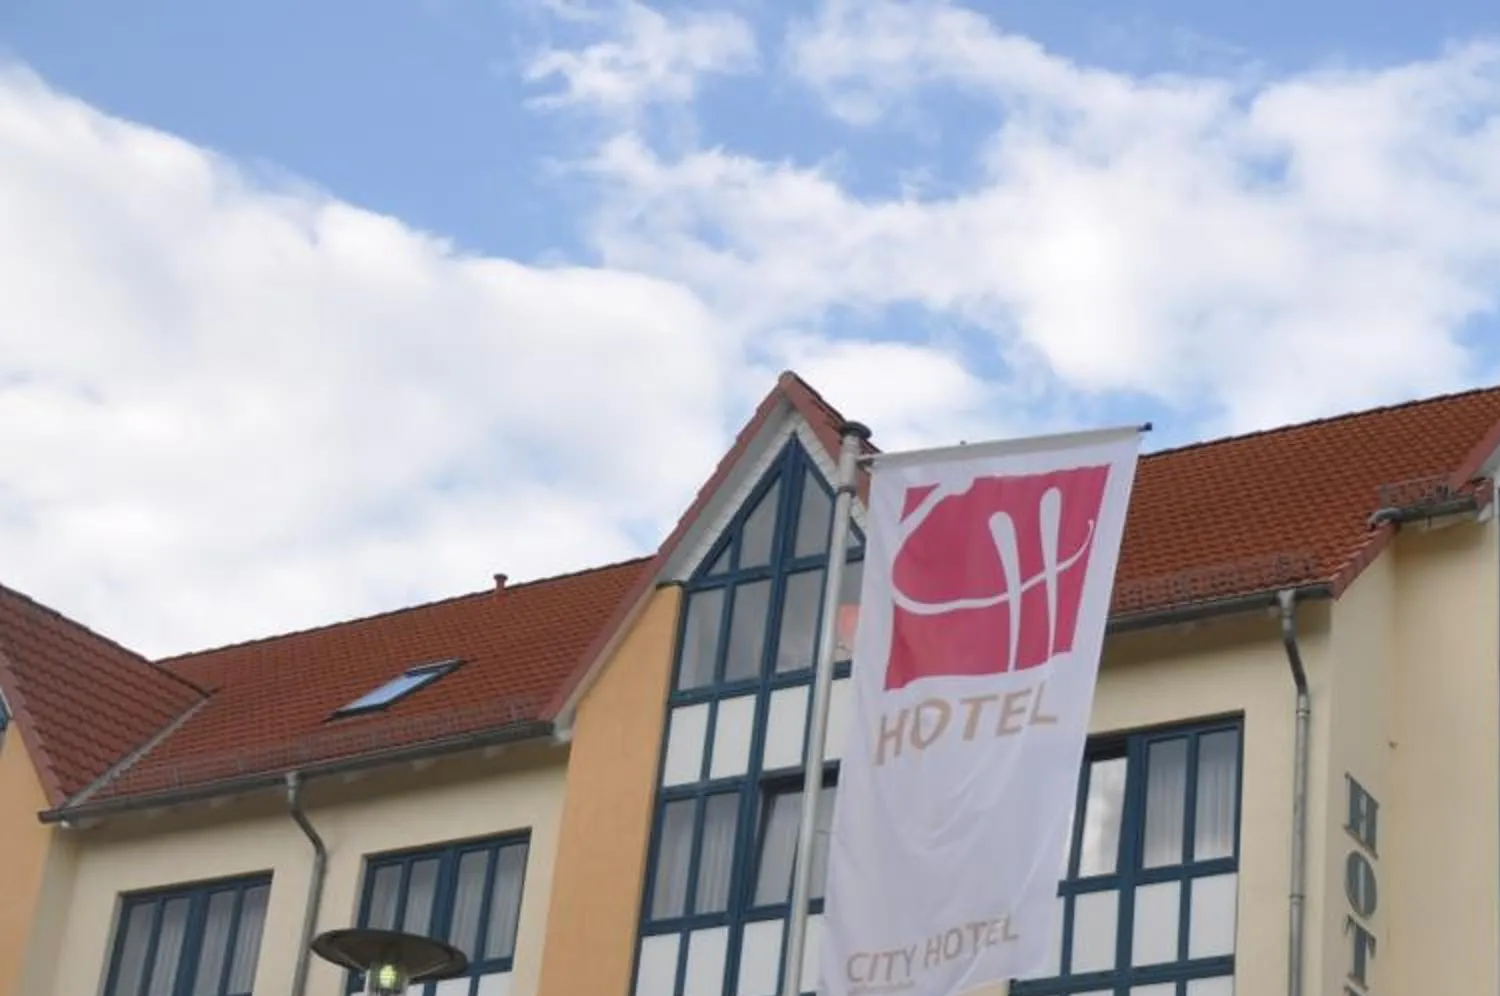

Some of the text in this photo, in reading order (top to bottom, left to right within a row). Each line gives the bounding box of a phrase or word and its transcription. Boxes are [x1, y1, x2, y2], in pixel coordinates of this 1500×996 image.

[873, 679, 1058, 766] HOTEL
[846, 912, 1020, 983] CITY HOTEL
